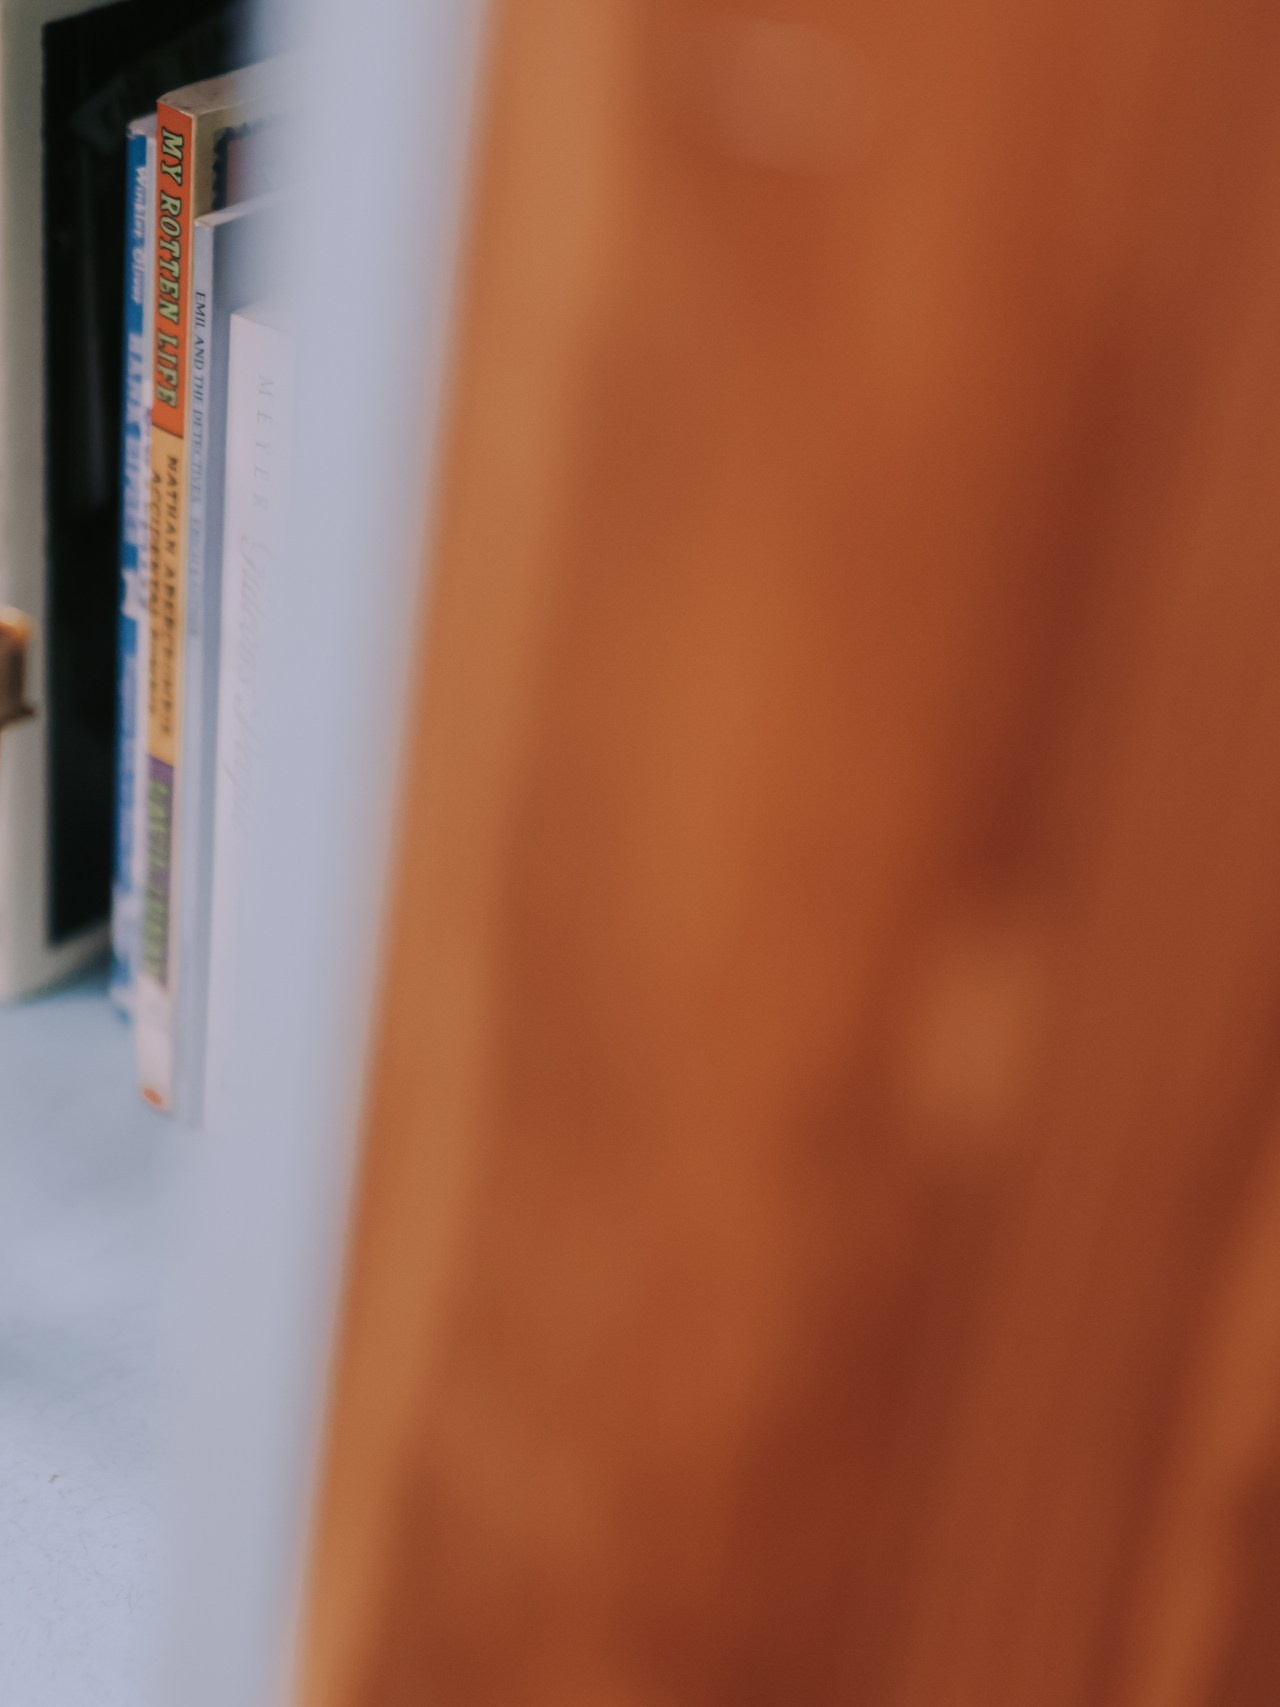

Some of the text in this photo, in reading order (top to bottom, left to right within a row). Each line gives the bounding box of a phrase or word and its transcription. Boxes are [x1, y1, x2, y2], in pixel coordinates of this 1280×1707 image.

[156, 127, 185, 409] MY ROTTEN LIFE
[193, 290, 207, 328] EMIL
[193, 334, 206, 371] AND
[193, 374, 205, 405] THE
[190, 408, 204, 504] DETECTIVES
[253, 374, 276, 513] MEYER
[165, 456, 180, 557] NATHAN
